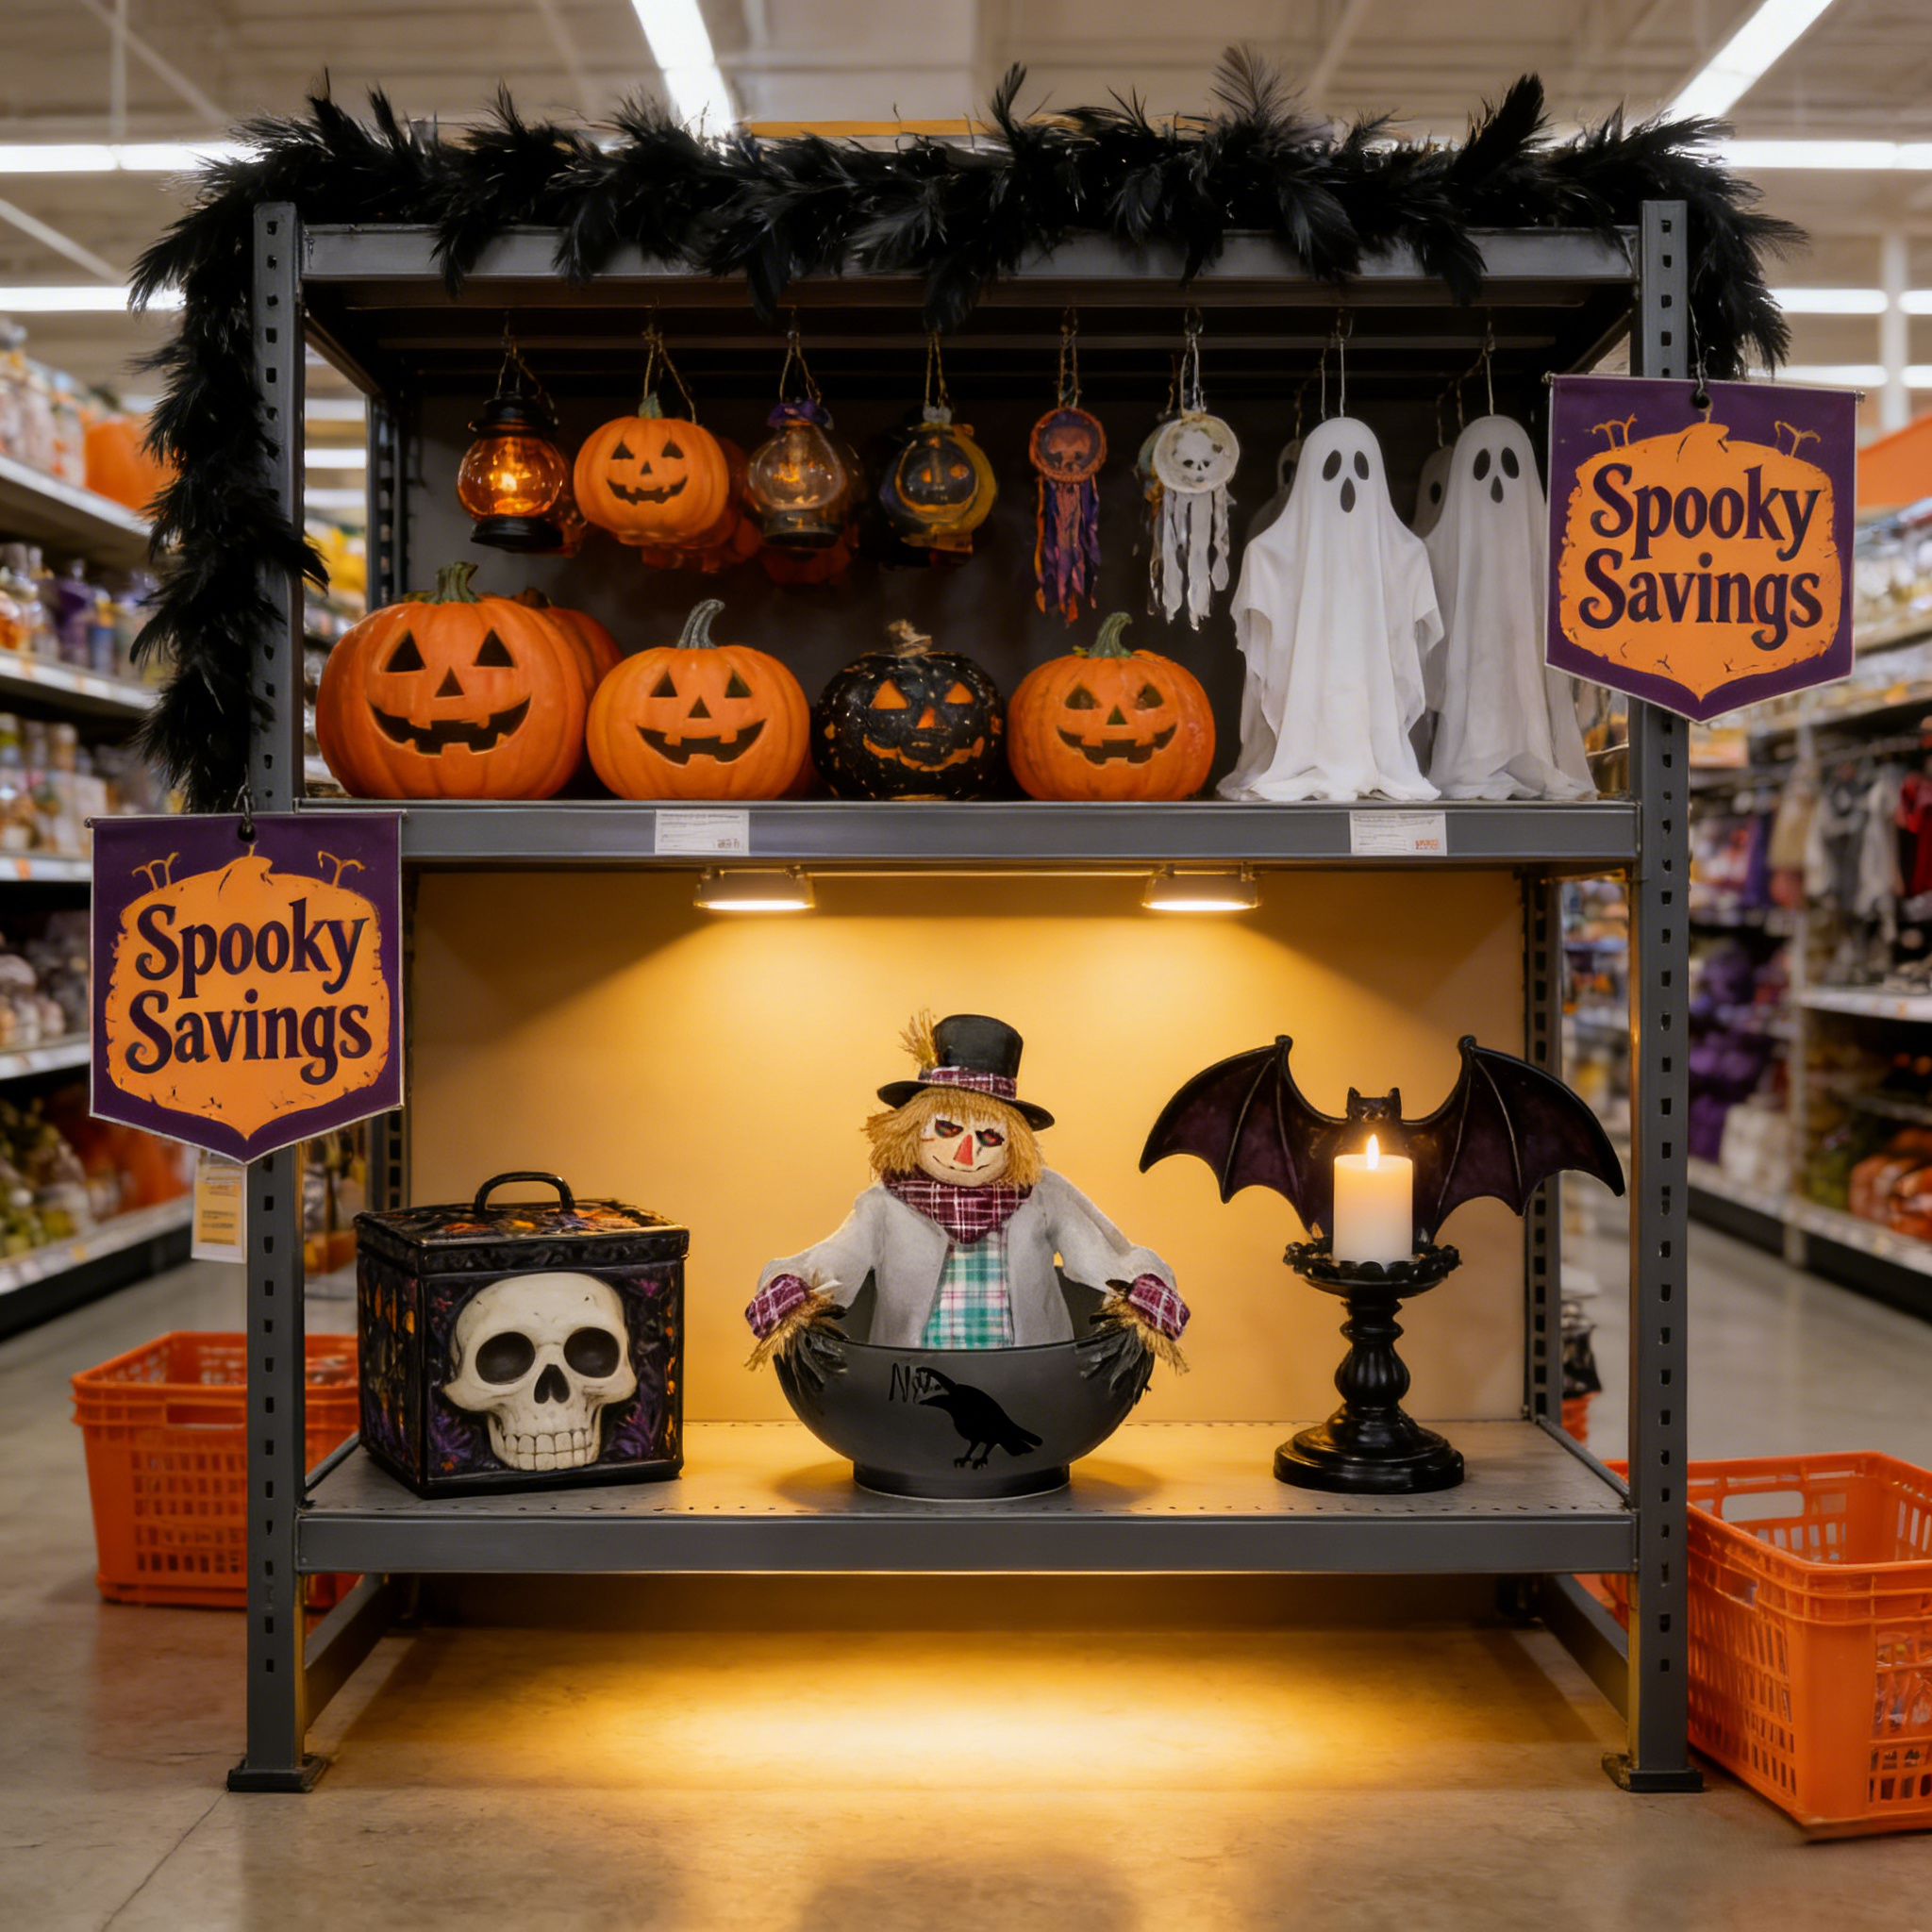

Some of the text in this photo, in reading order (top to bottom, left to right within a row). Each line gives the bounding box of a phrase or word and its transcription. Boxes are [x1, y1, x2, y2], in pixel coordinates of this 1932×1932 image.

[1590, 462, 1822, 561] Spooky
[1578, 548, 1824, 651] Savings
[135, 897, 370, 999] Spooky
[125, 989, 373, 1086] Savings
